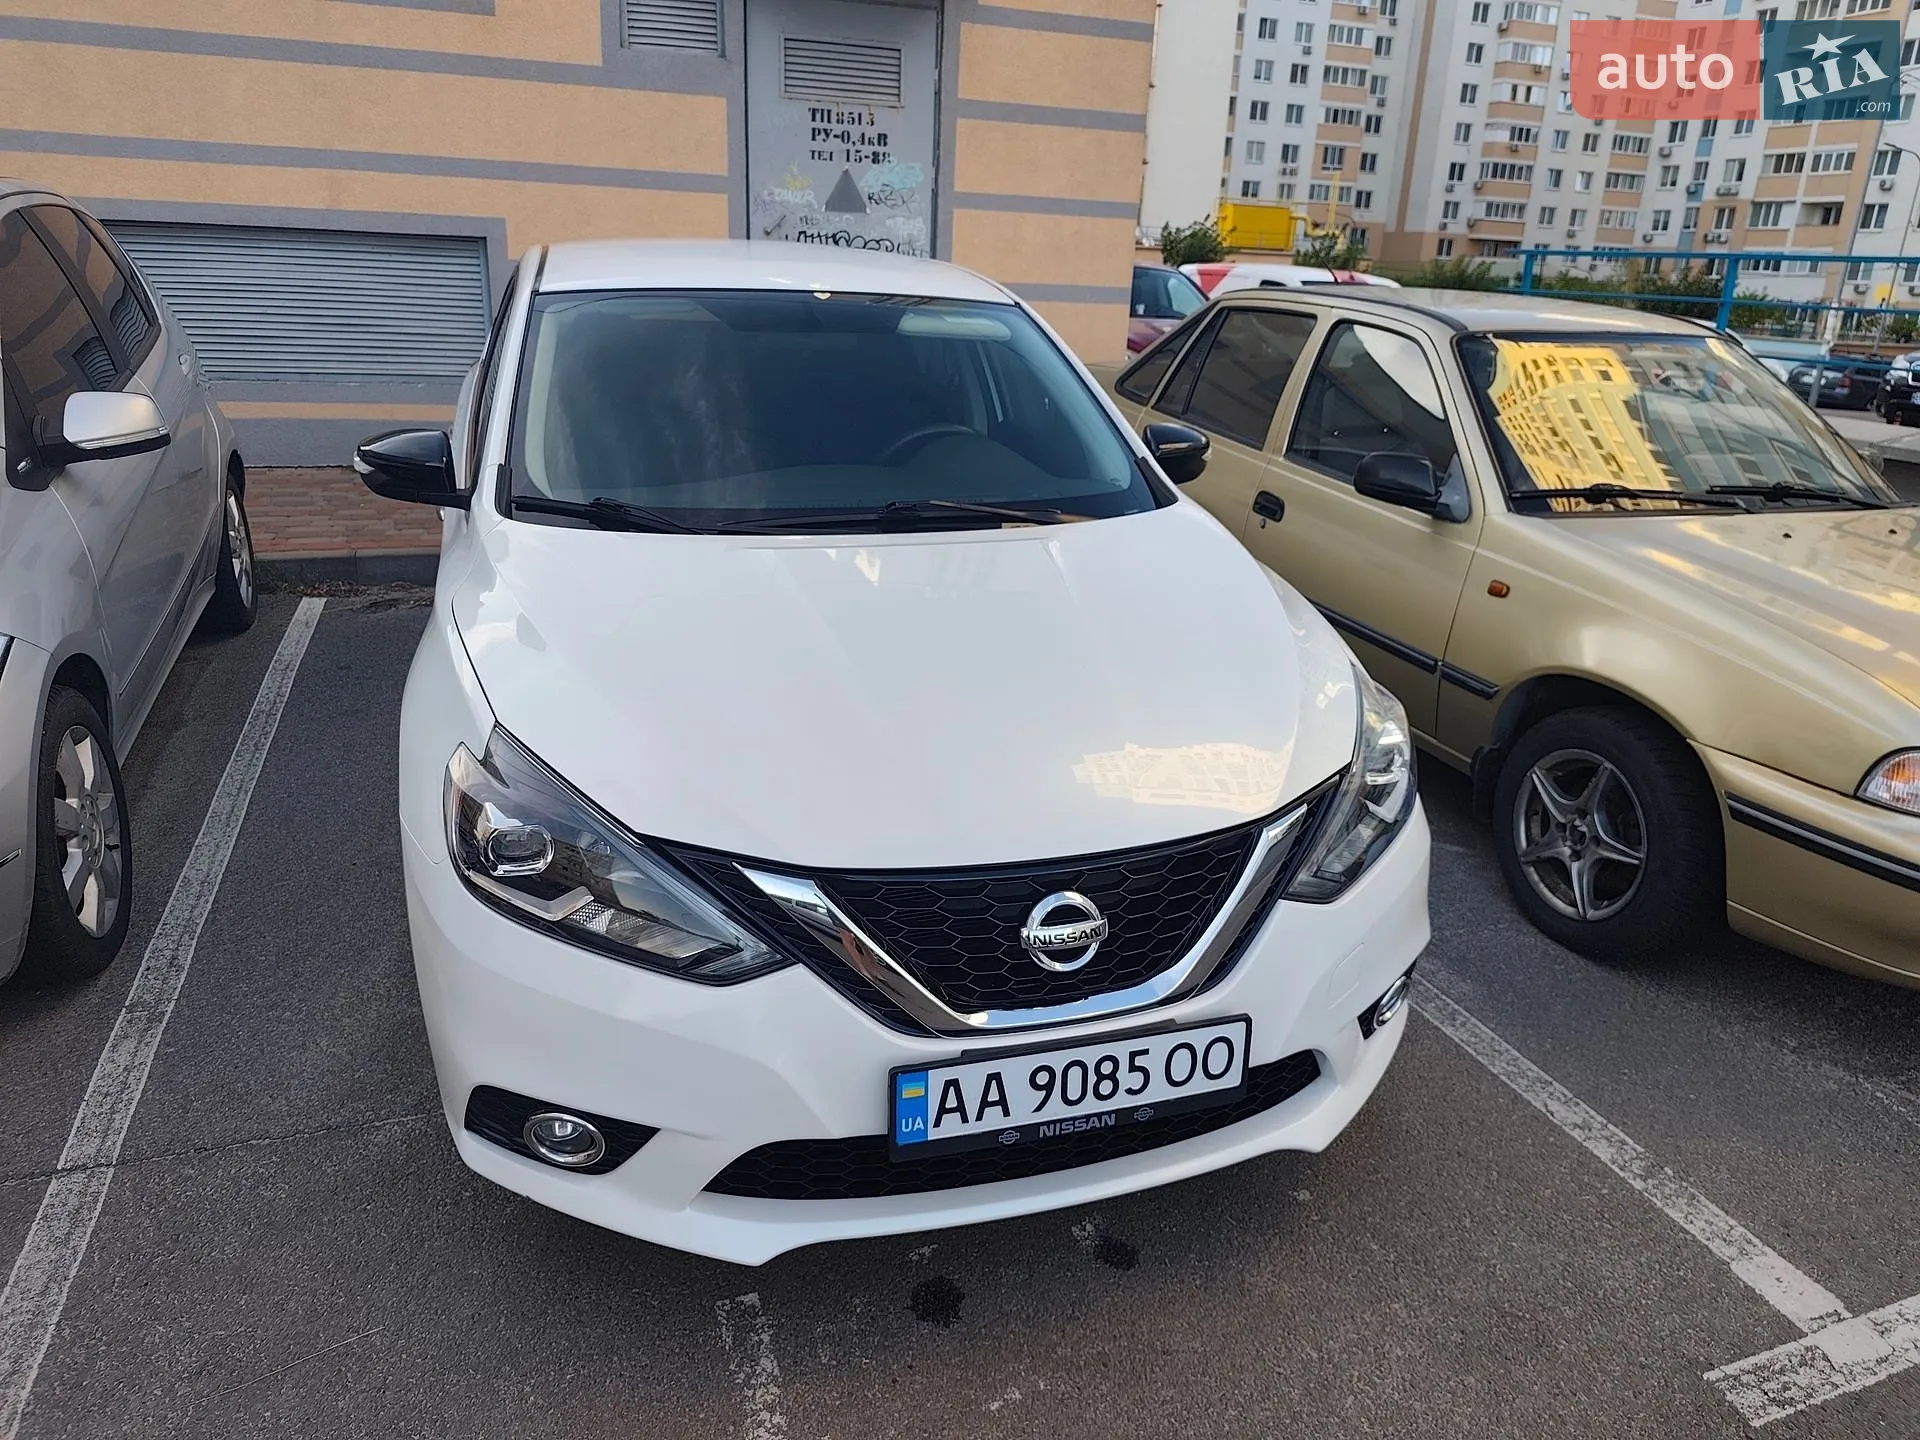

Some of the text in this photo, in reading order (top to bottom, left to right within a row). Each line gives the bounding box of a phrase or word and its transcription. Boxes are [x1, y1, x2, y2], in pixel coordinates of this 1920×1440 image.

[808, 107, 832, 124] ТП
[1032, 925, 1101, 946] NISSAN
[932, 1072, 1011, 1129] AA
[1028, 1048, 1151, 1114] 9085
[901, 1117, 925, 1132] UA
[1038, 1113, 1116, 1138] NISSAN
